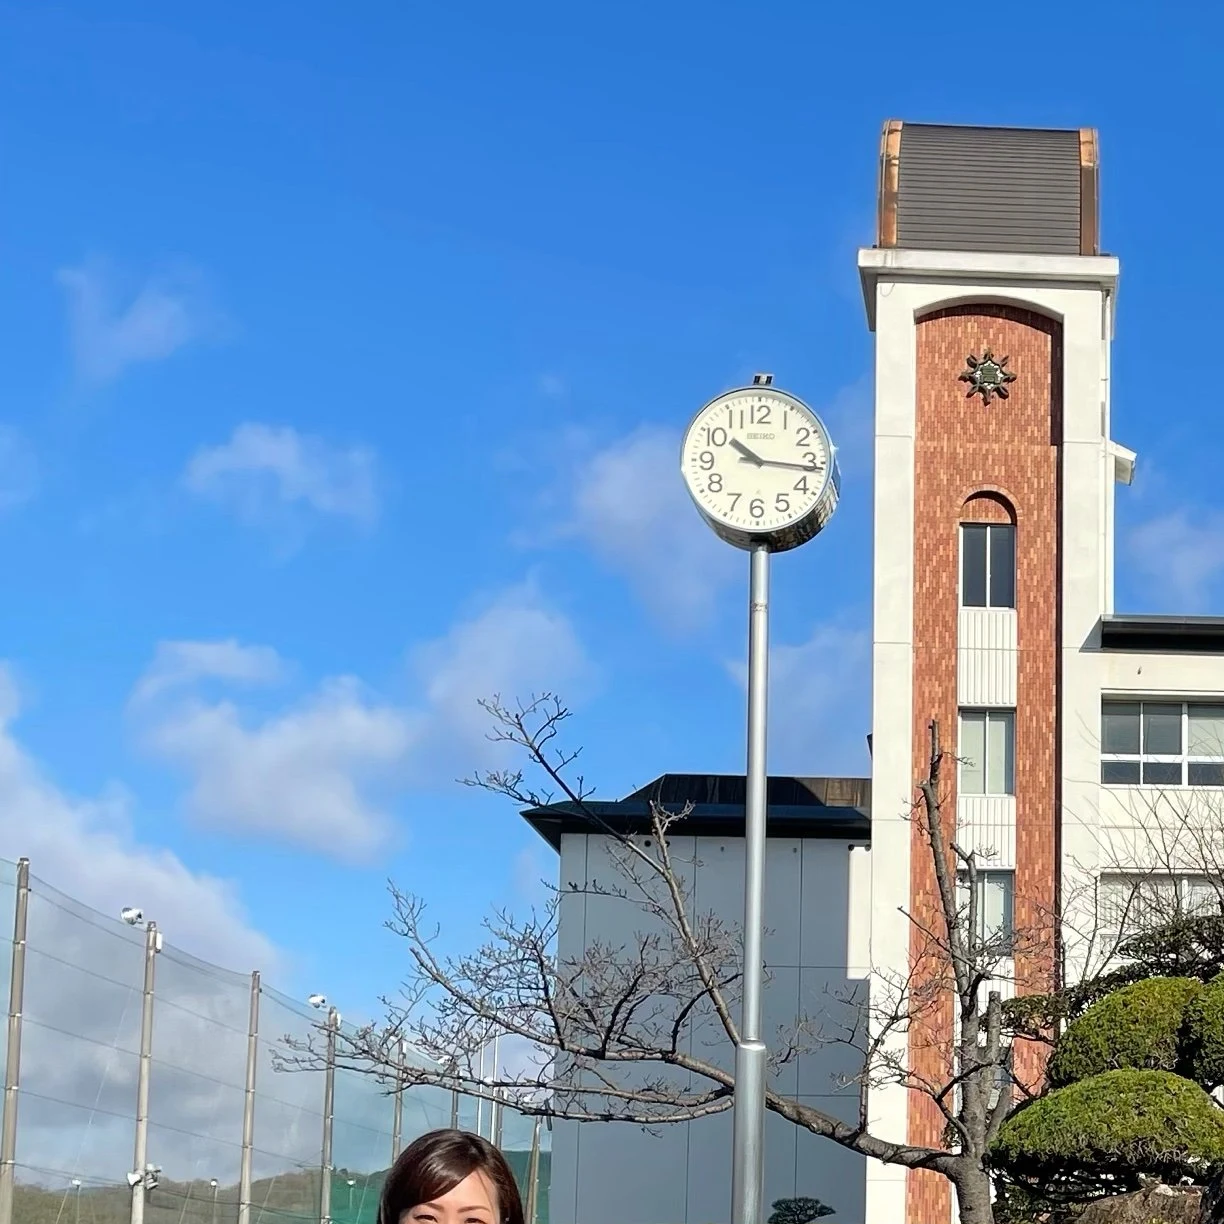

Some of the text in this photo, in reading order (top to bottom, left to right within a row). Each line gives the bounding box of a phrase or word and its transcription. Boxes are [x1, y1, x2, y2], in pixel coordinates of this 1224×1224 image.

[729, 409, 744, 429] 11
[750, 405, 772, 424] 12
[783, 410, 788, 430] 1
[706, 427, 728, 447] 10
[746, 432, 776, 440] SEIKO
[795, 427, 811, 447] 2
[699, 451, 715, 471] 9
[802, 452, 817, 472] 3
[707, 473, 723, 493] 8
[793, 475, 810, 495] 4
[727, 493, 742, 512] 7
[749, 498, 765, 518] 6
[774, 493, 790, 513] 5
